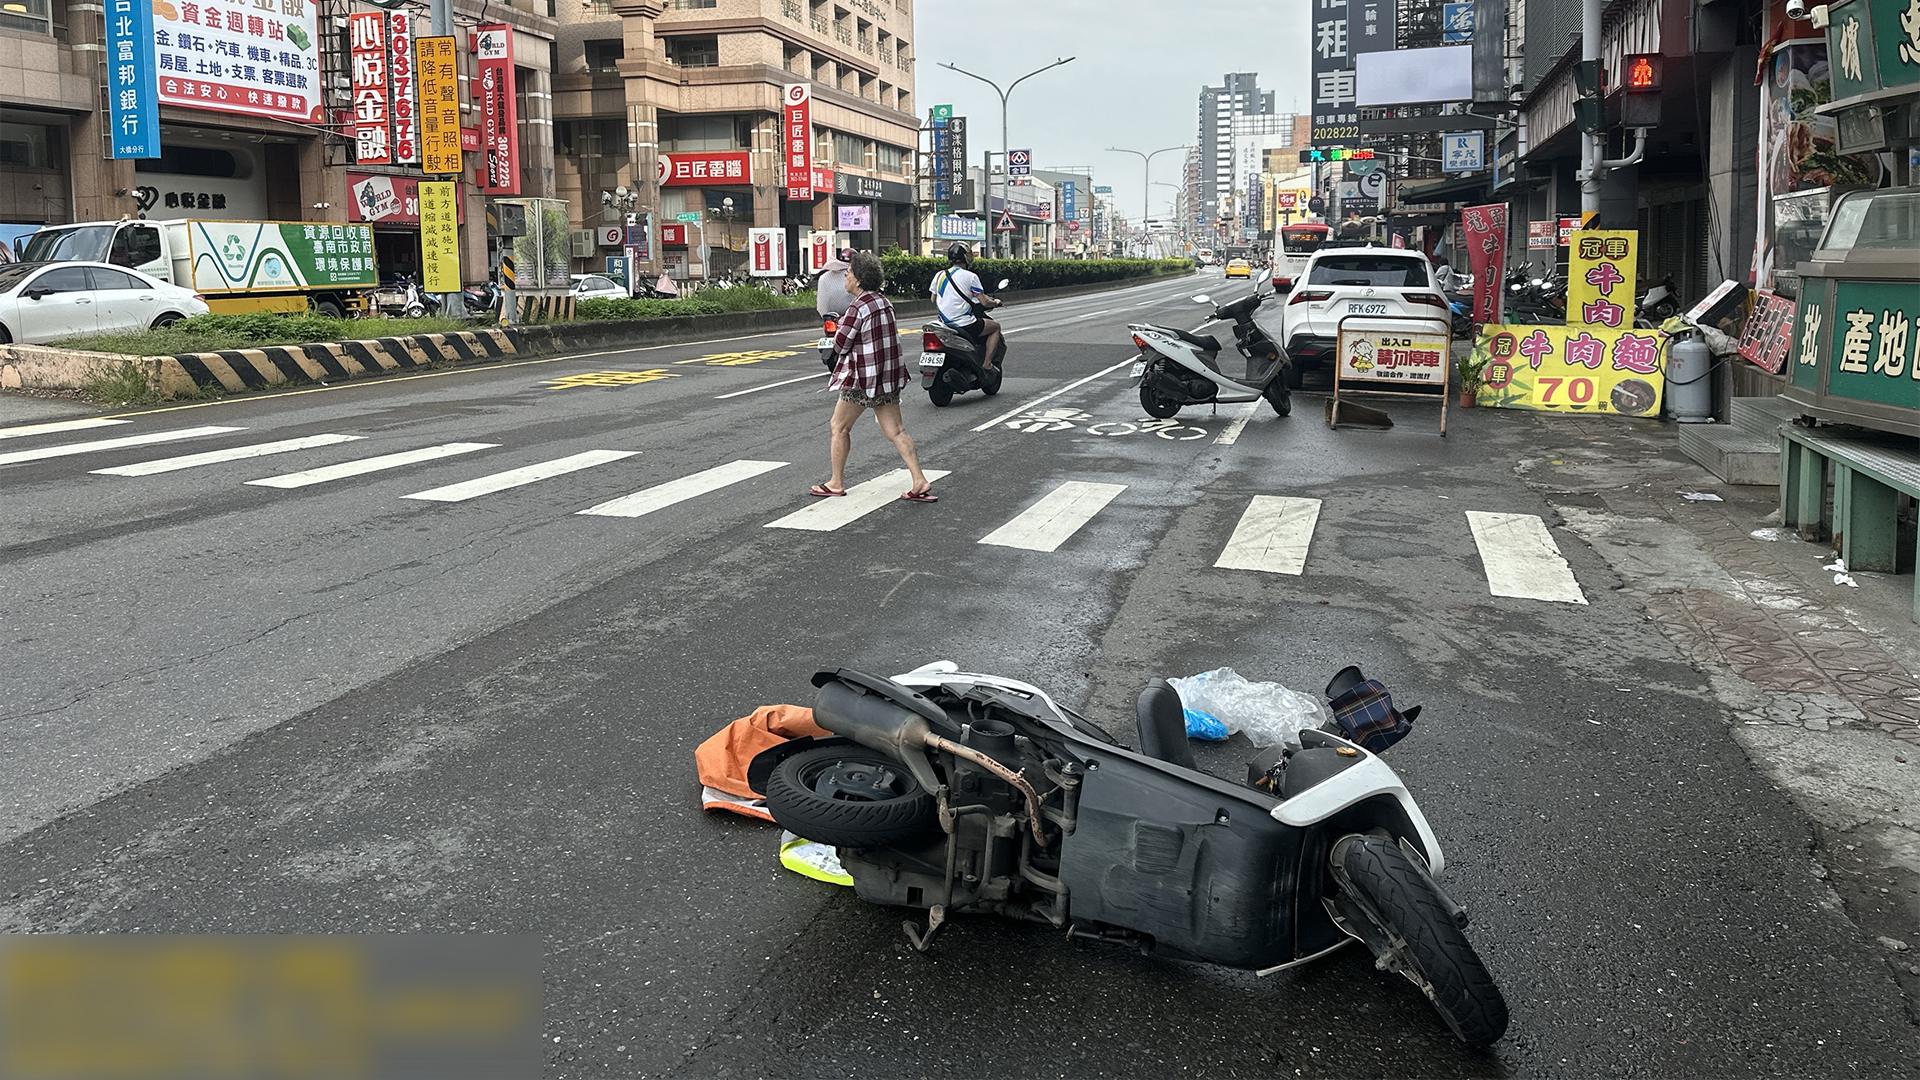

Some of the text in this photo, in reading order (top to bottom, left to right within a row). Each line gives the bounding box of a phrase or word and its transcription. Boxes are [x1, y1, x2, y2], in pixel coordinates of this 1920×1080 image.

[181, 1, 284, 42] 資金週轉站
[352, 15, 389, 160] 心悅金融
[391, 14, 412, 160] 3037676
[419, 41, 442, 171] 請降低音量行駛
[437, 40, 459, 170] 常有聲音照相
[1315, 113, 1358, 125] 租車專線
[791, 109, 805, 168] 巨匠電腦
[1313, 126, 1359, 140] 2028222
[119, 145, 145, 154] 大橋分行
[497, 136, 511, 188] 302-2225
[675, 160, 742, 179] 巨匠電腦
[1011, 167, 1028, 175] 全聯
[789, 187, 809, 198] 巨匠
[369, 201, 389, 216] GYM
[439, 185, 454, 255] 前方道路施工
[303, 225, 371, 240] 資源回收車
[313, 240, 372, 254] 臺南市政府
[1580, 239, 1628, 259] 冠軍
[315, 257, 374, 271] 環境保護局
[1585, 263, 1624, 327] 牛肉
[1381, 337, 1411, 347] 出入口
[1519, 329, 1659, 374] 牛肉麵
[1839, 308, 1920, 379] 產地
[1377, 348, 1440, 369] 請勿停車
[1491, 338, 1512, 385] 冠軍
[1538, 377, 1594, 403] 70
